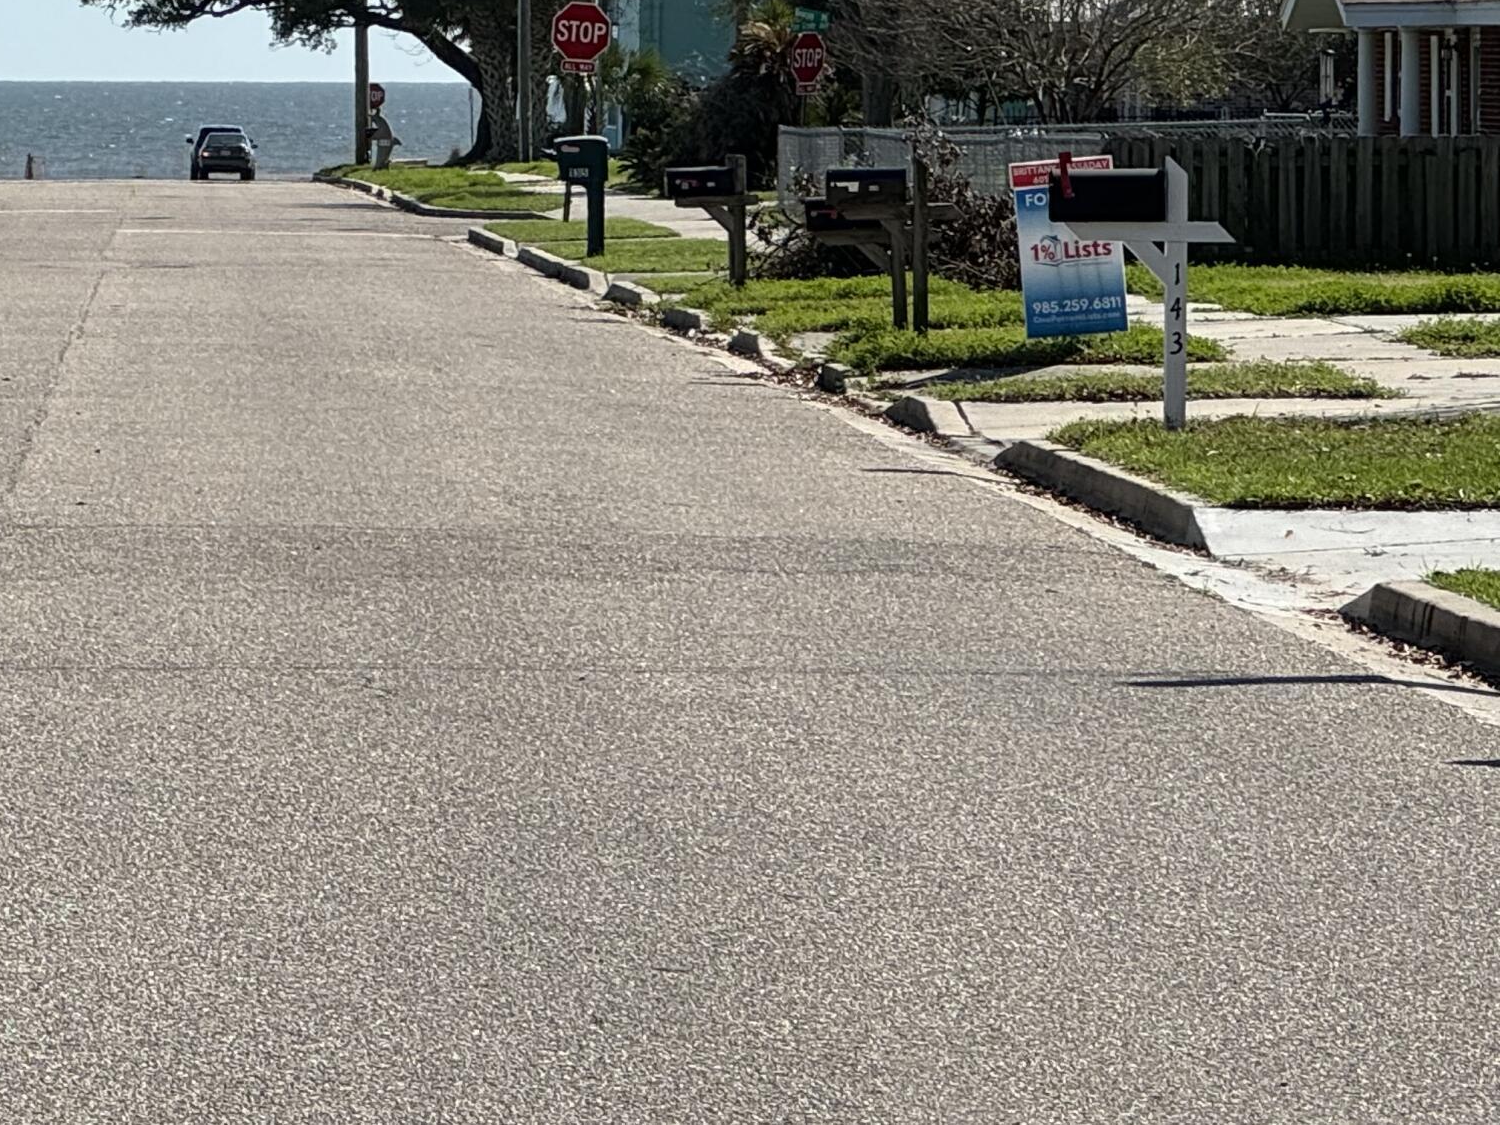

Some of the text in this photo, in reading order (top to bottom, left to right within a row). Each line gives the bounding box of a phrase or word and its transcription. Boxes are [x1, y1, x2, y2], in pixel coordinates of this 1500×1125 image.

[556, 20, 607, 44] STOP
[794, 48, 823, 68] STOP
[1025, 192, 1047, 207] FO
[1030, 240, 1112, 262] 1% Lists
[1033, 296, 1122, 314] 985.259.6811
